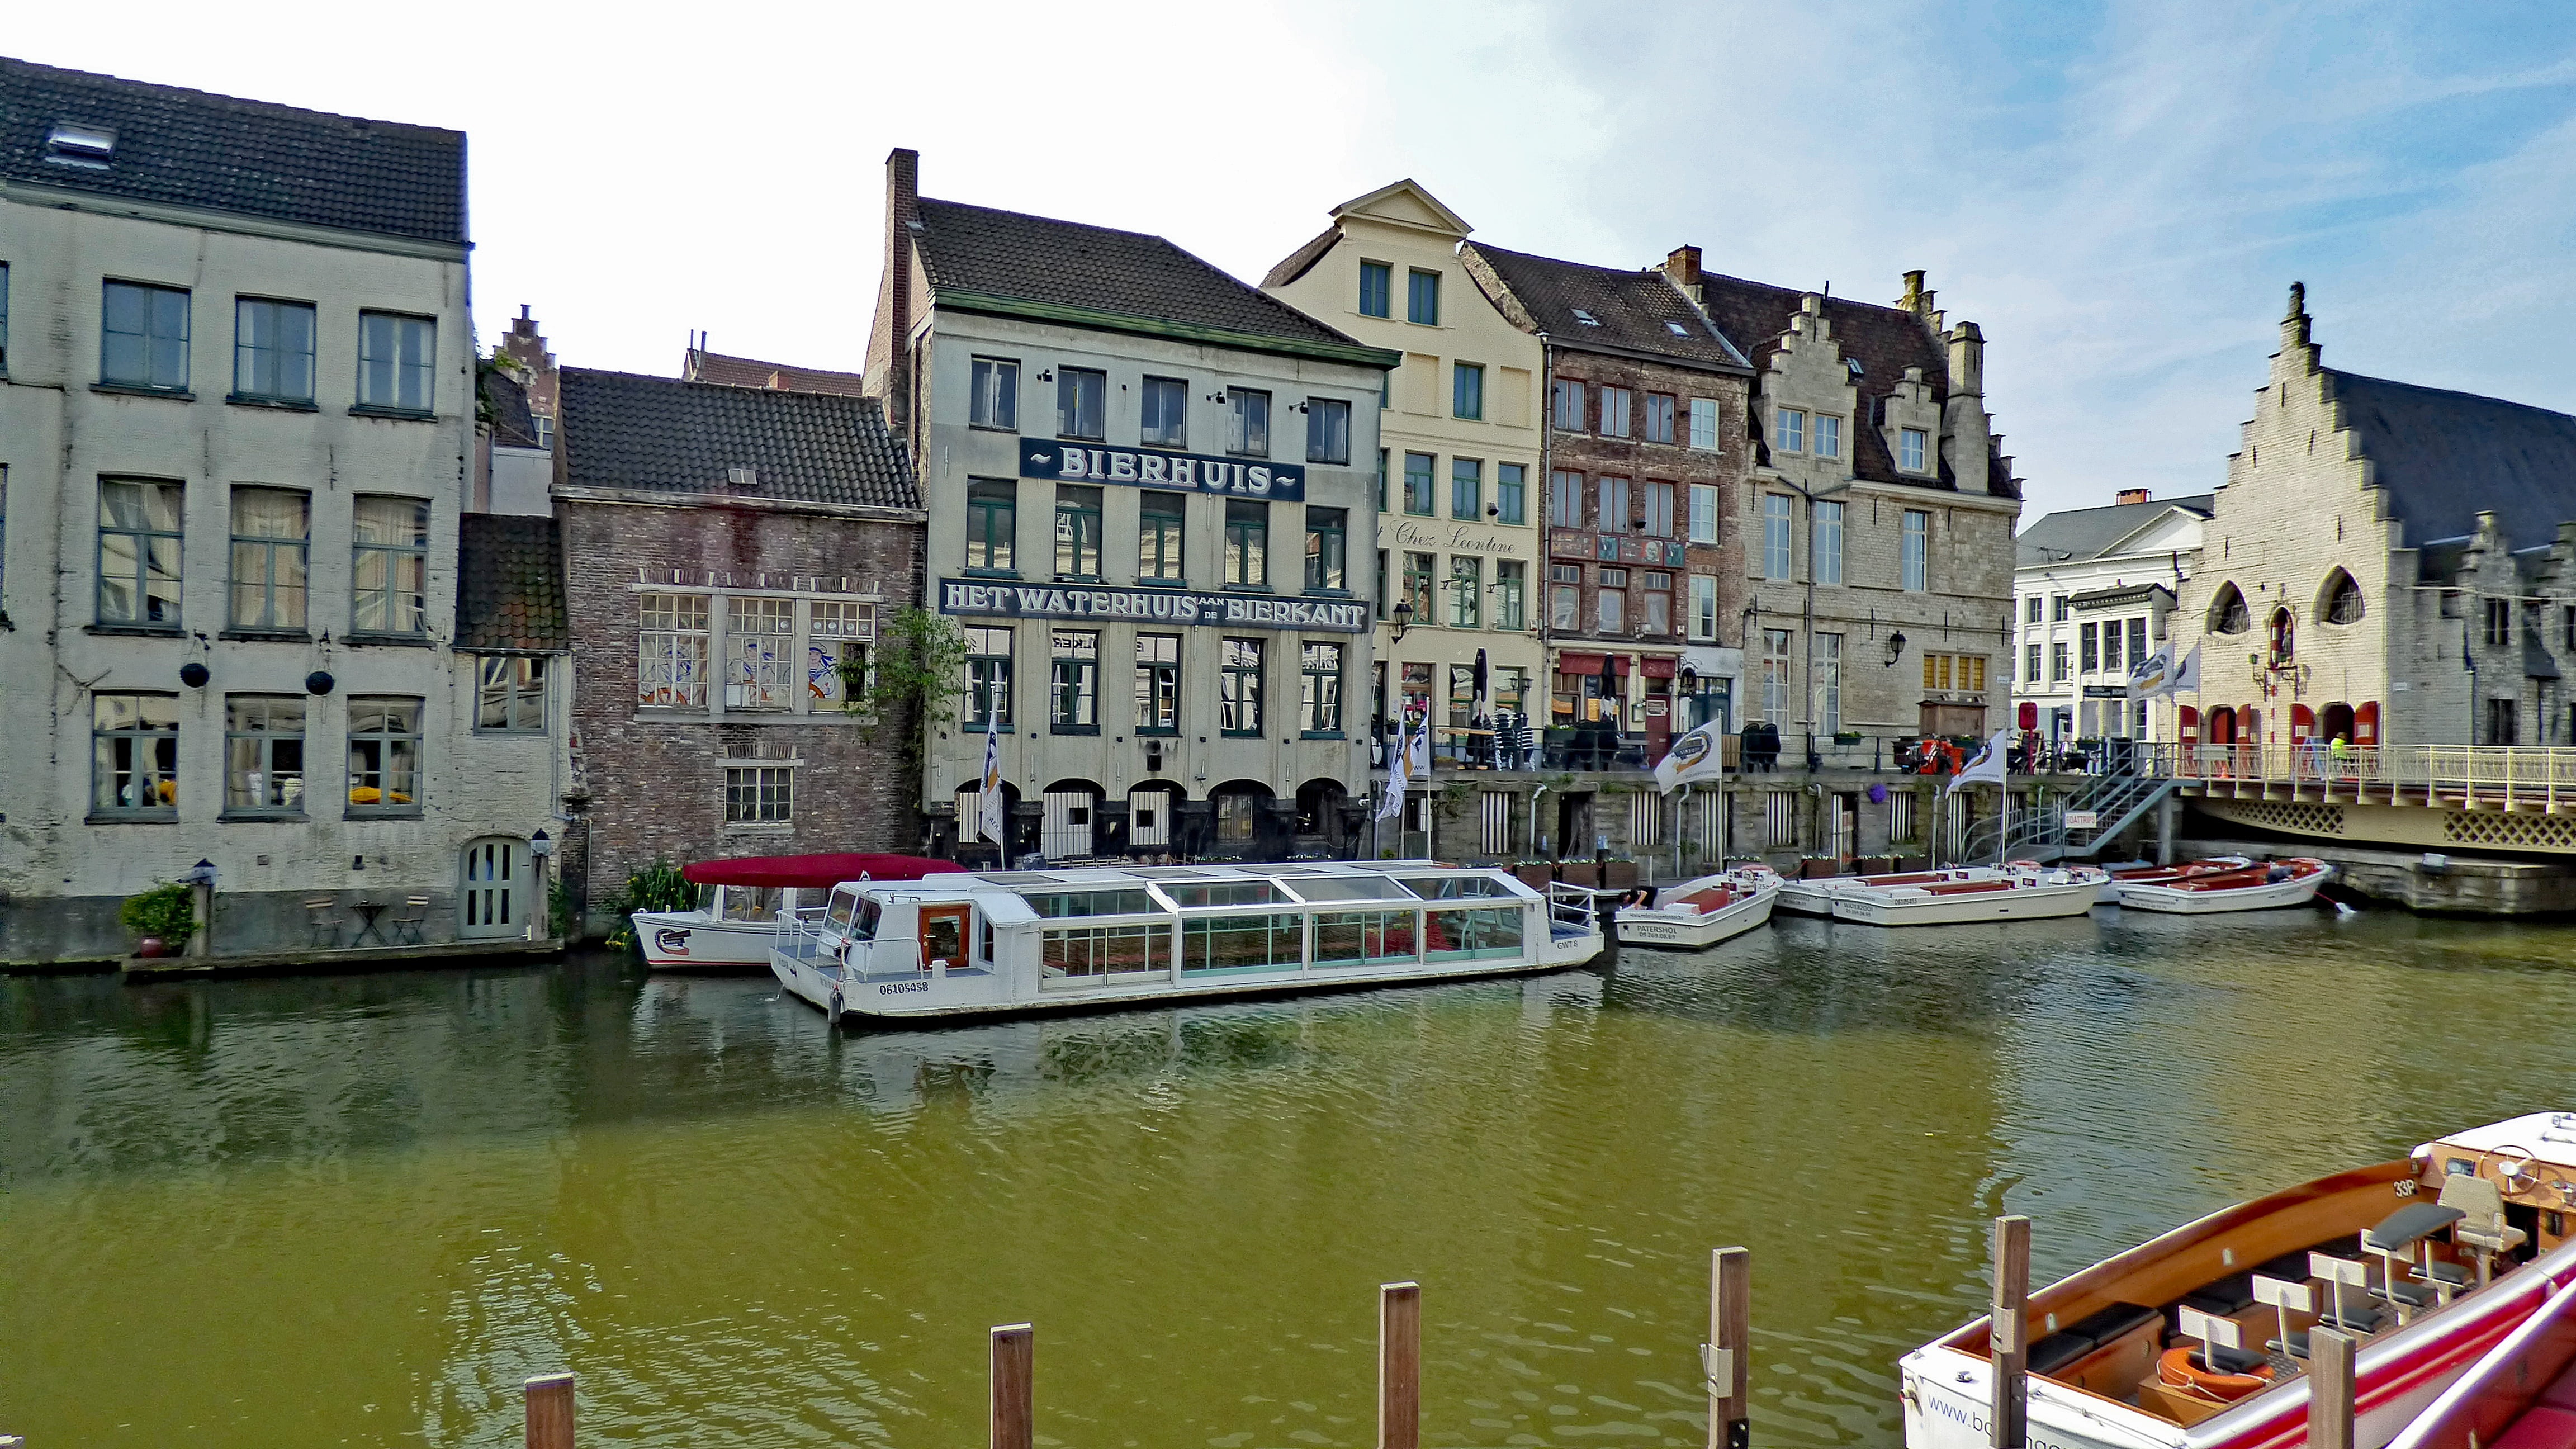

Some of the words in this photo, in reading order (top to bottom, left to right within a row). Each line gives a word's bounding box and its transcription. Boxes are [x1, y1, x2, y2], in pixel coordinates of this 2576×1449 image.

[1059, 447, 1272, 494] BIERHUIS
[1390, 520, 1436, 546] Chez
[1444, 524, 1516, 553] Leontine
[945, 584, 1012, 611] HET
[1014, 588, 1199, 620] WATERHUIS
[1198, 596, 1225, 606] AAN
[1204, 611, 1218, 619] DE
[1225, 598, 1366, 628] BIERKANT
[1637, 925, 1677, 934] PATERSHOL
[879, 982, 929, 995] 06105458
